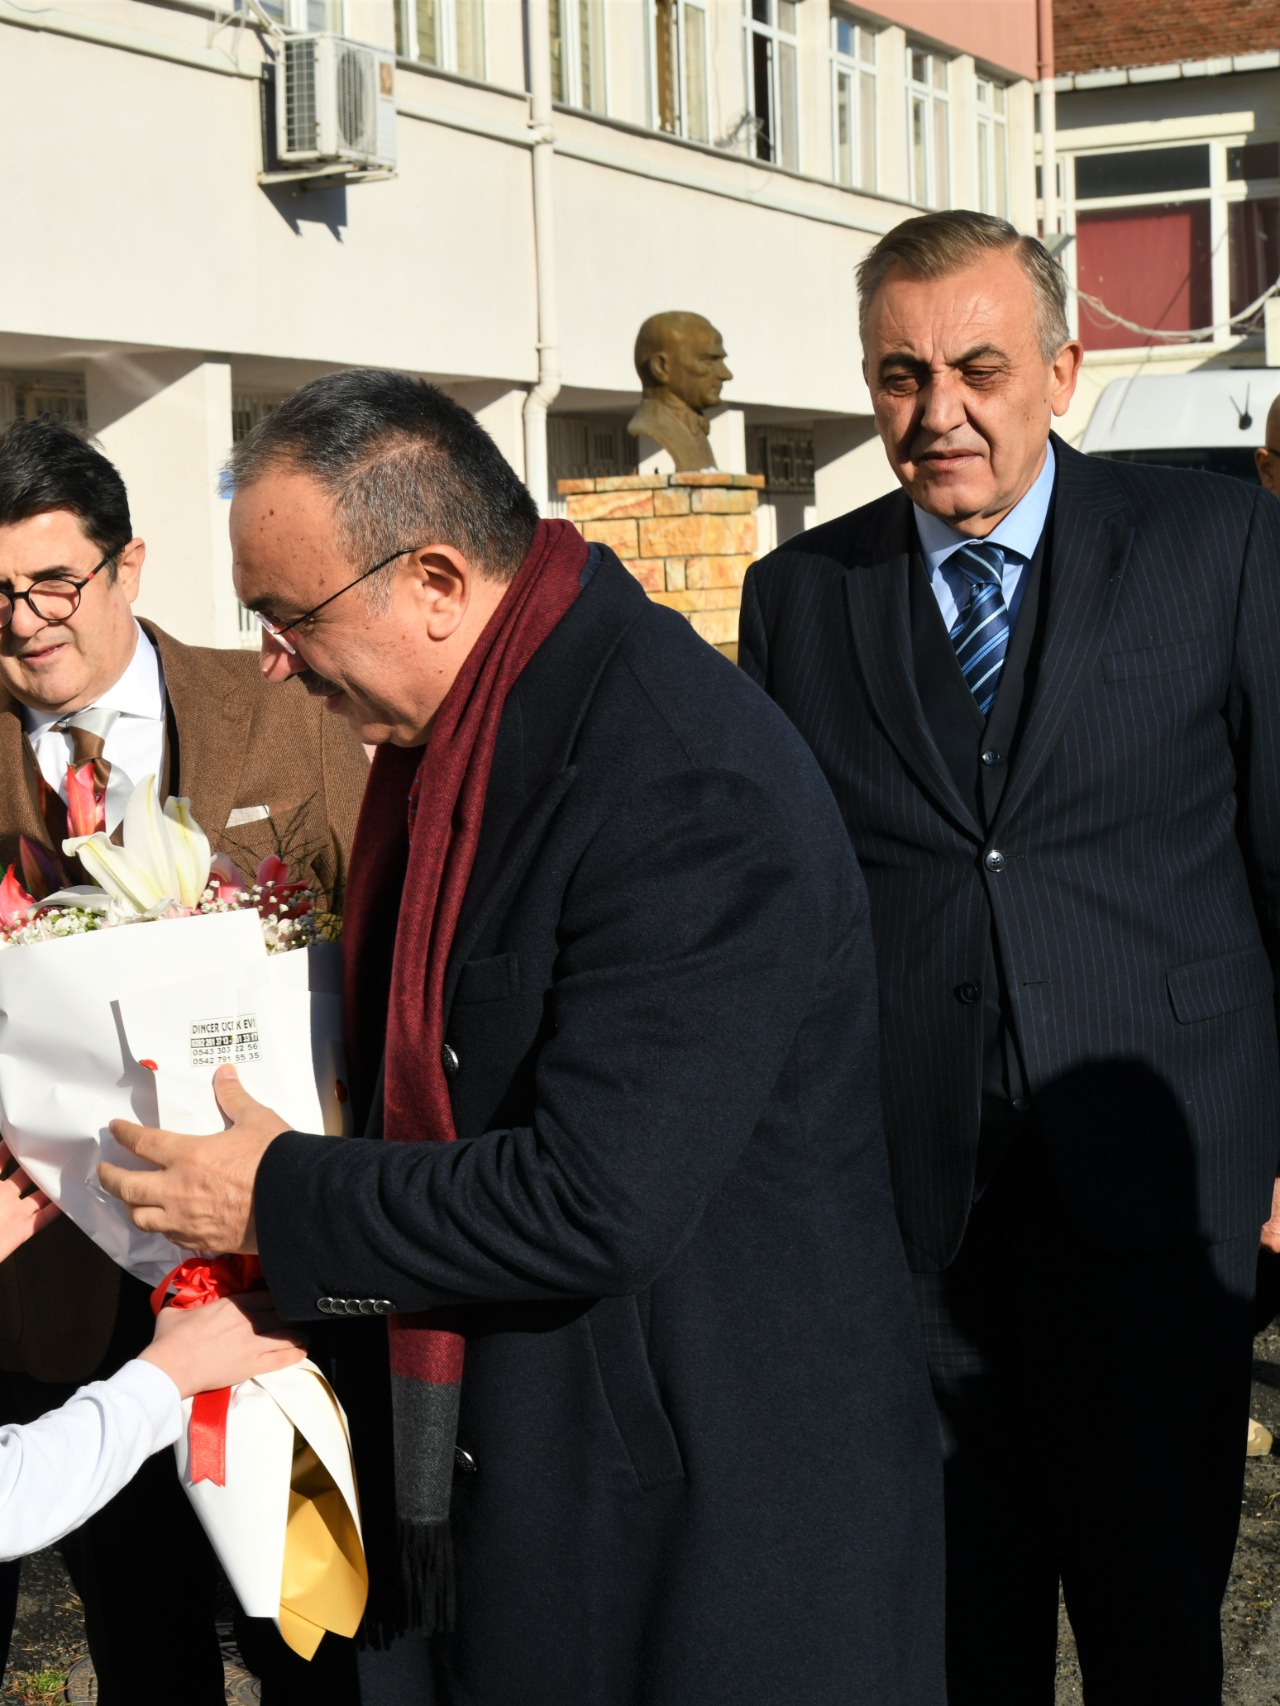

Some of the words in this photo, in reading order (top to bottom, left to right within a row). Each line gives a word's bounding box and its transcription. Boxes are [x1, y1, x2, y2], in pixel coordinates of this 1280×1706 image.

[192, 1048, 214, 1056] 0543
[217, 1046, 231, 1054] 303
[235, 1044, 245, 1052] 22
[247, 1042, 258, 1050] 56
[192, 1057, 215, 1065] 0542
[235, 1054, 246, 1062] 55
[249, 1051, 260, 1060] 35
